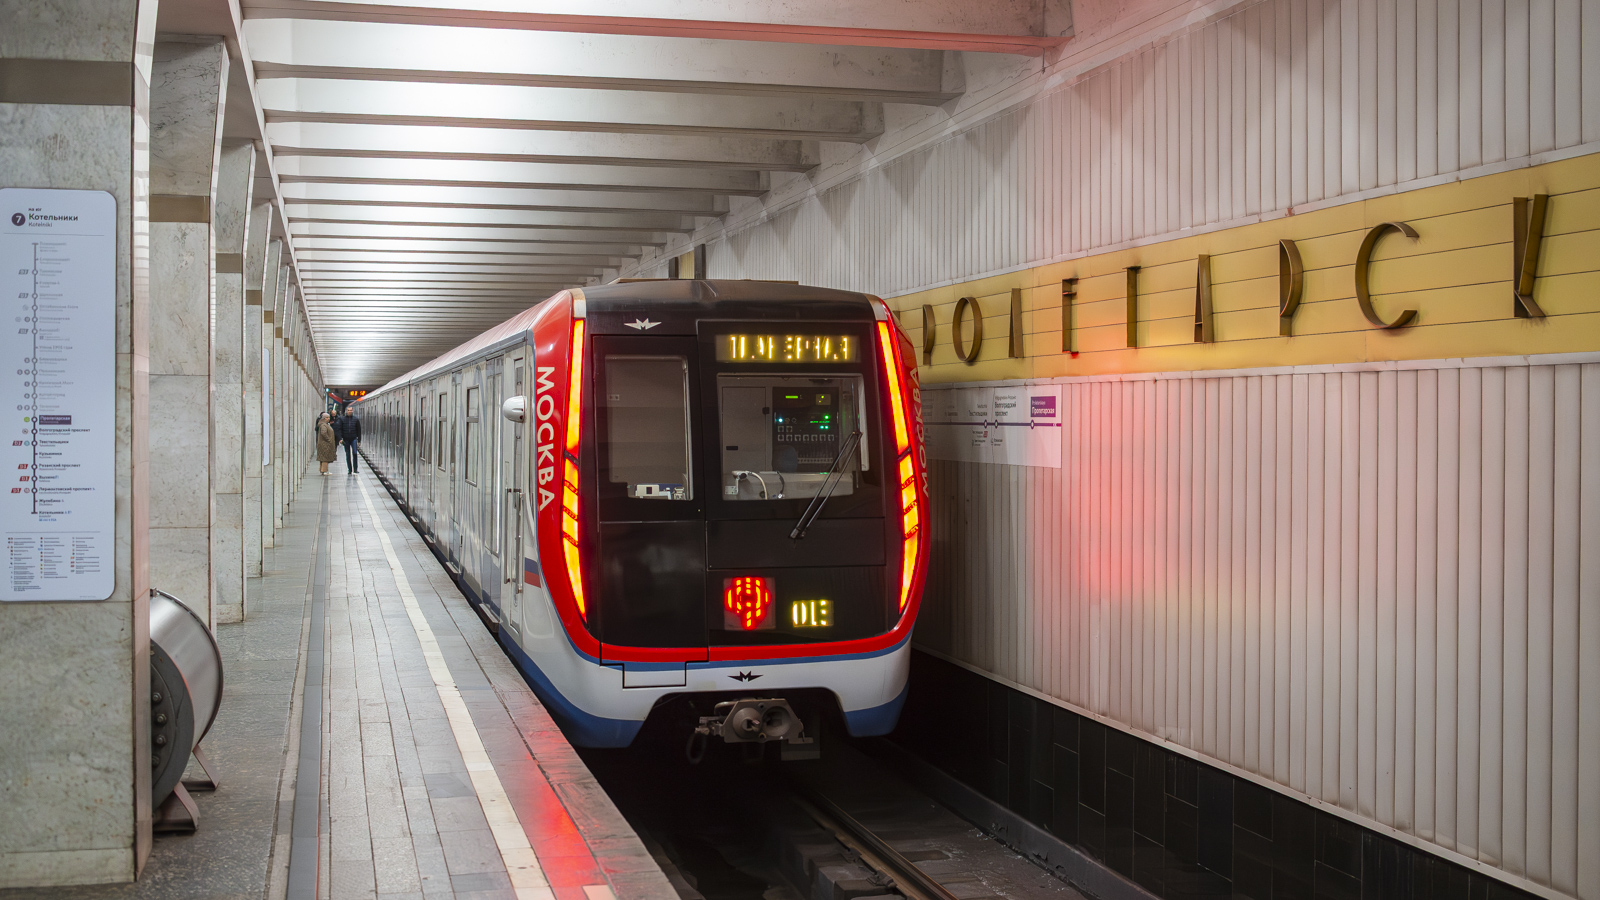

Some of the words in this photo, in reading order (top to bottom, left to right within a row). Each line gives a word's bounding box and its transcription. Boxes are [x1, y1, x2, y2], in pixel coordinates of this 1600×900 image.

[28, 213, 79, 221] Котельники
[1032, 407, 1055, 415] Пролетарская
[536, 366, 555, 511] МОСКВА
